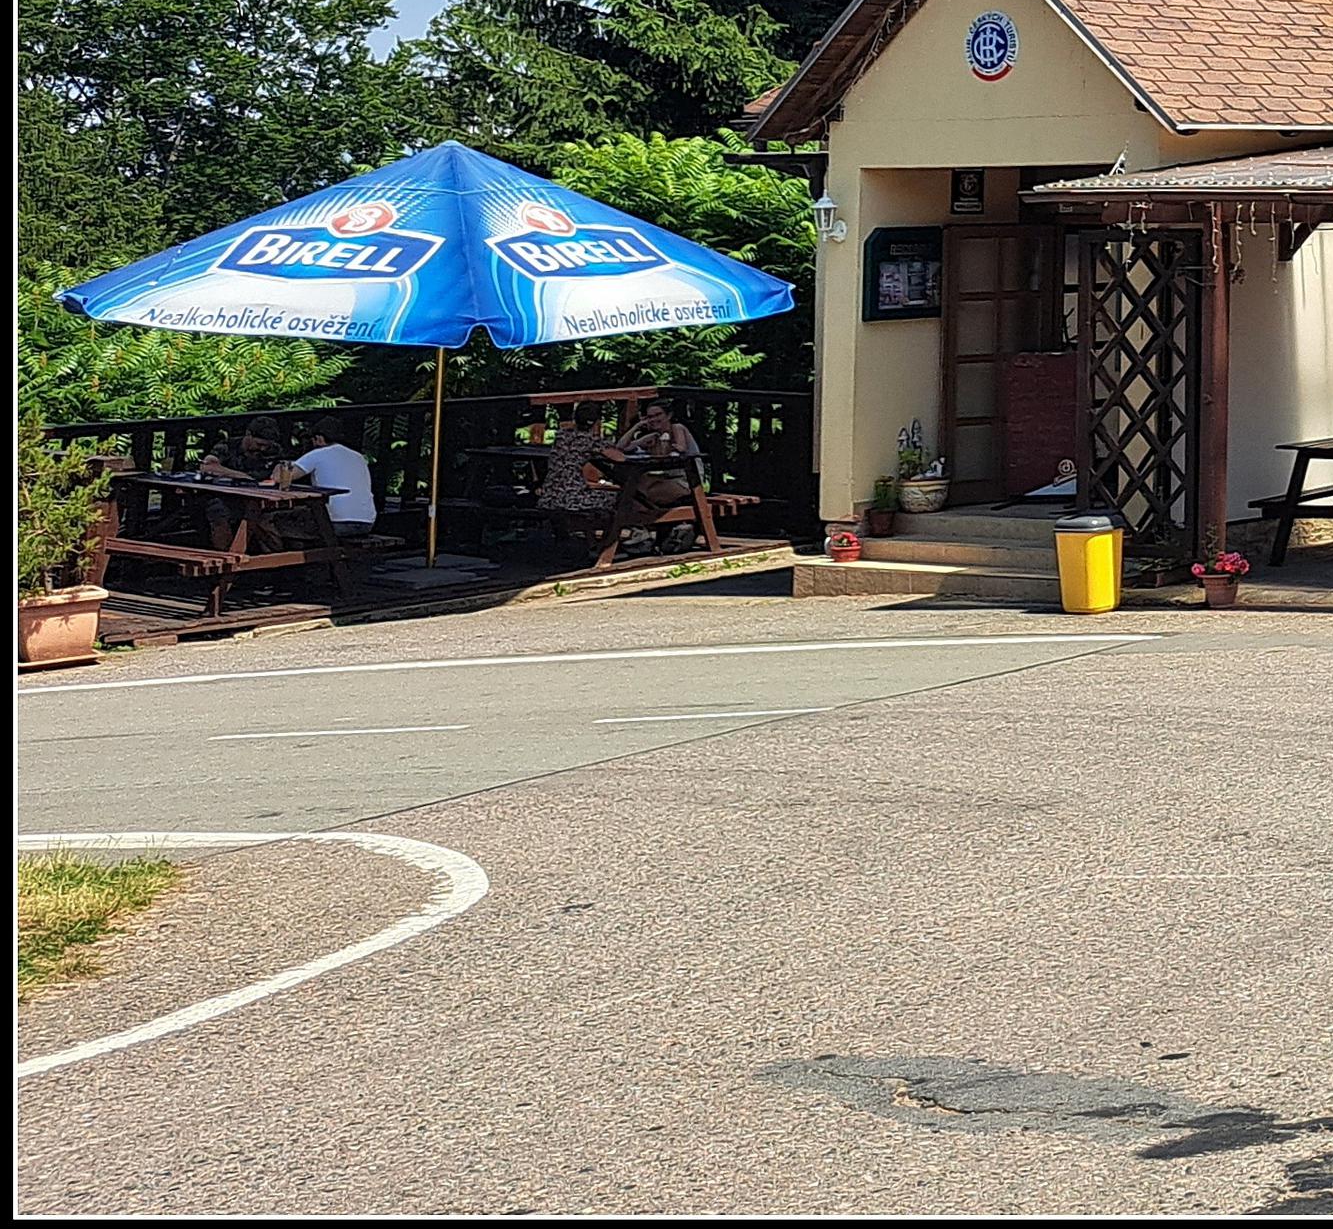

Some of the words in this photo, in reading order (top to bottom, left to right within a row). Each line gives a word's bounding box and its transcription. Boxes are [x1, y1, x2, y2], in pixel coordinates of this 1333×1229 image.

[236, 233, 403, 272] BIRELL
[508, 238, 658, 272] BIRELL
[139, 306, 285, 331] Nealkoholické
[287, 314, 382, 338] osvěžení
[562, 300, 671, 336] Nealkoholické
[674, 298, 732, 321] osvěžení
